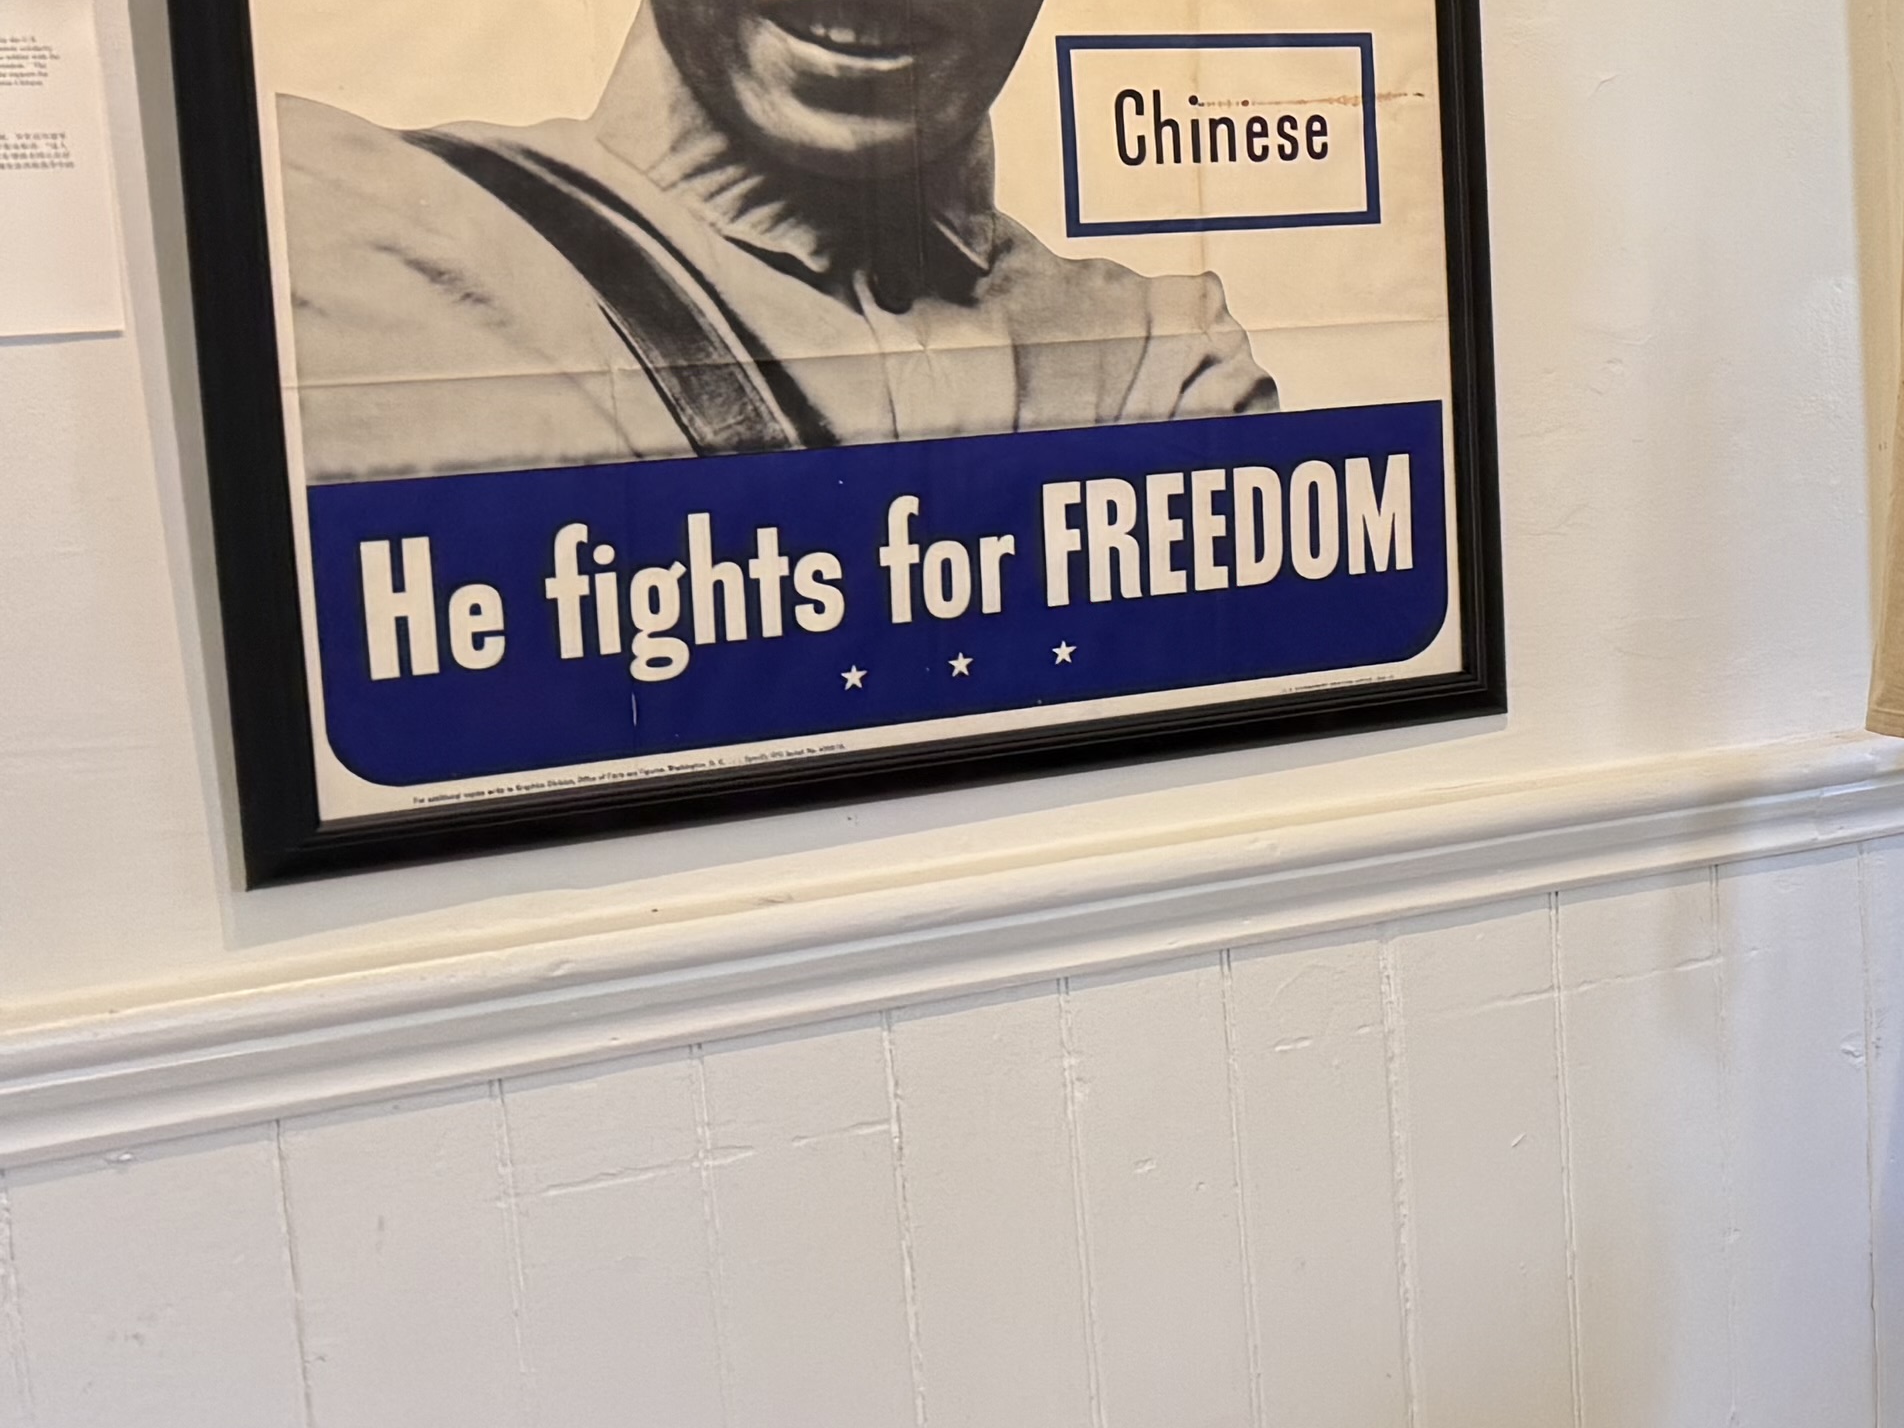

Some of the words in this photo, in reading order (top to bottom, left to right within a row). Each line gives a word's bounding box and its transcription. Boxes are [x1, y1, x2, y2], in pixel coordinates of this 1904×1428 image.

[1114, 88, 1329, 166] Chinese
[359, 535, 507, 681] He
[544, 511, 846, 682] fights
[878, 495, 1015, 624] for
[1041, 452, 1413, 608] FREEDOM
